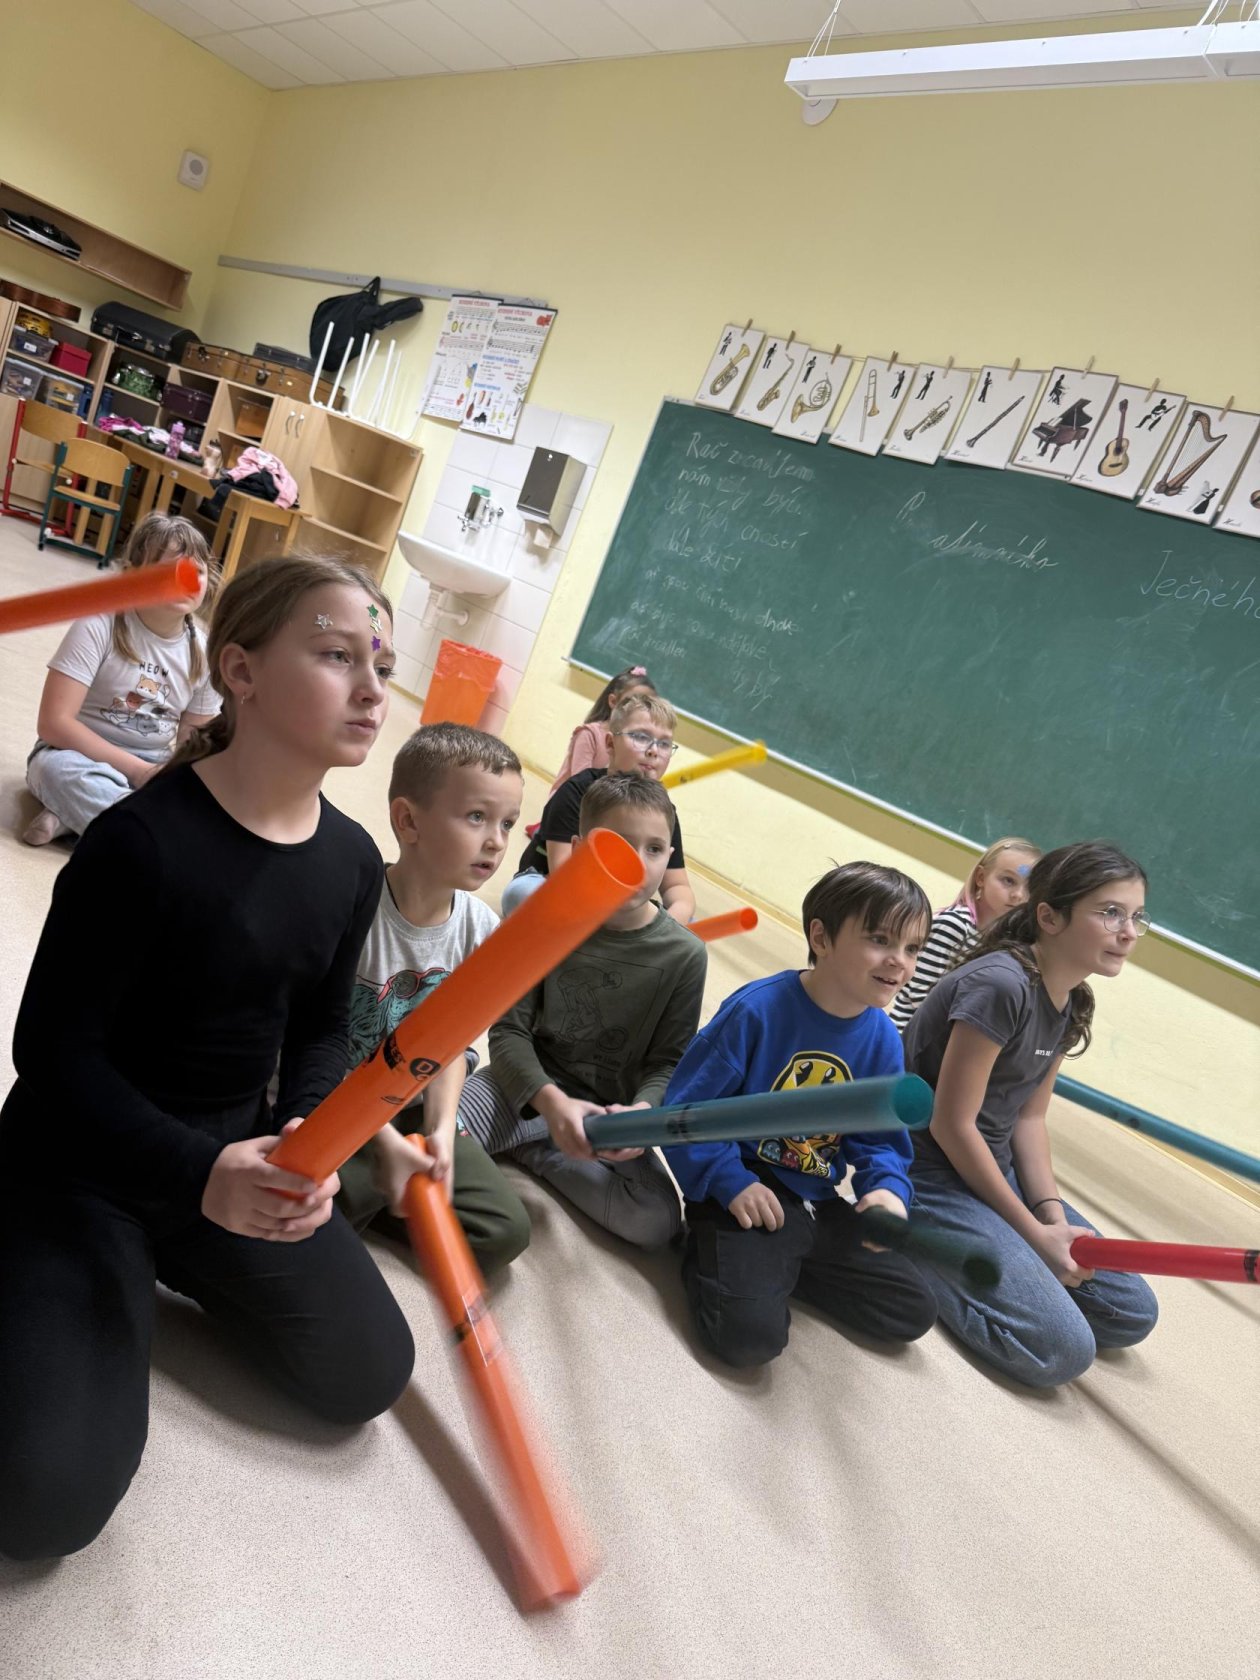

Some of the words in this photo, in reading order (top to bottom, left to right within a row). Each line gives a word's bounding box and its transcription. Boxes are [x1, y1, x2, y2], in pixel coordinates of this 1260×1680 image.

[686, 431, 729, 459] Rač
[678, 465, 711, 487] nám
[139, 661, 169, 678] MEOW
